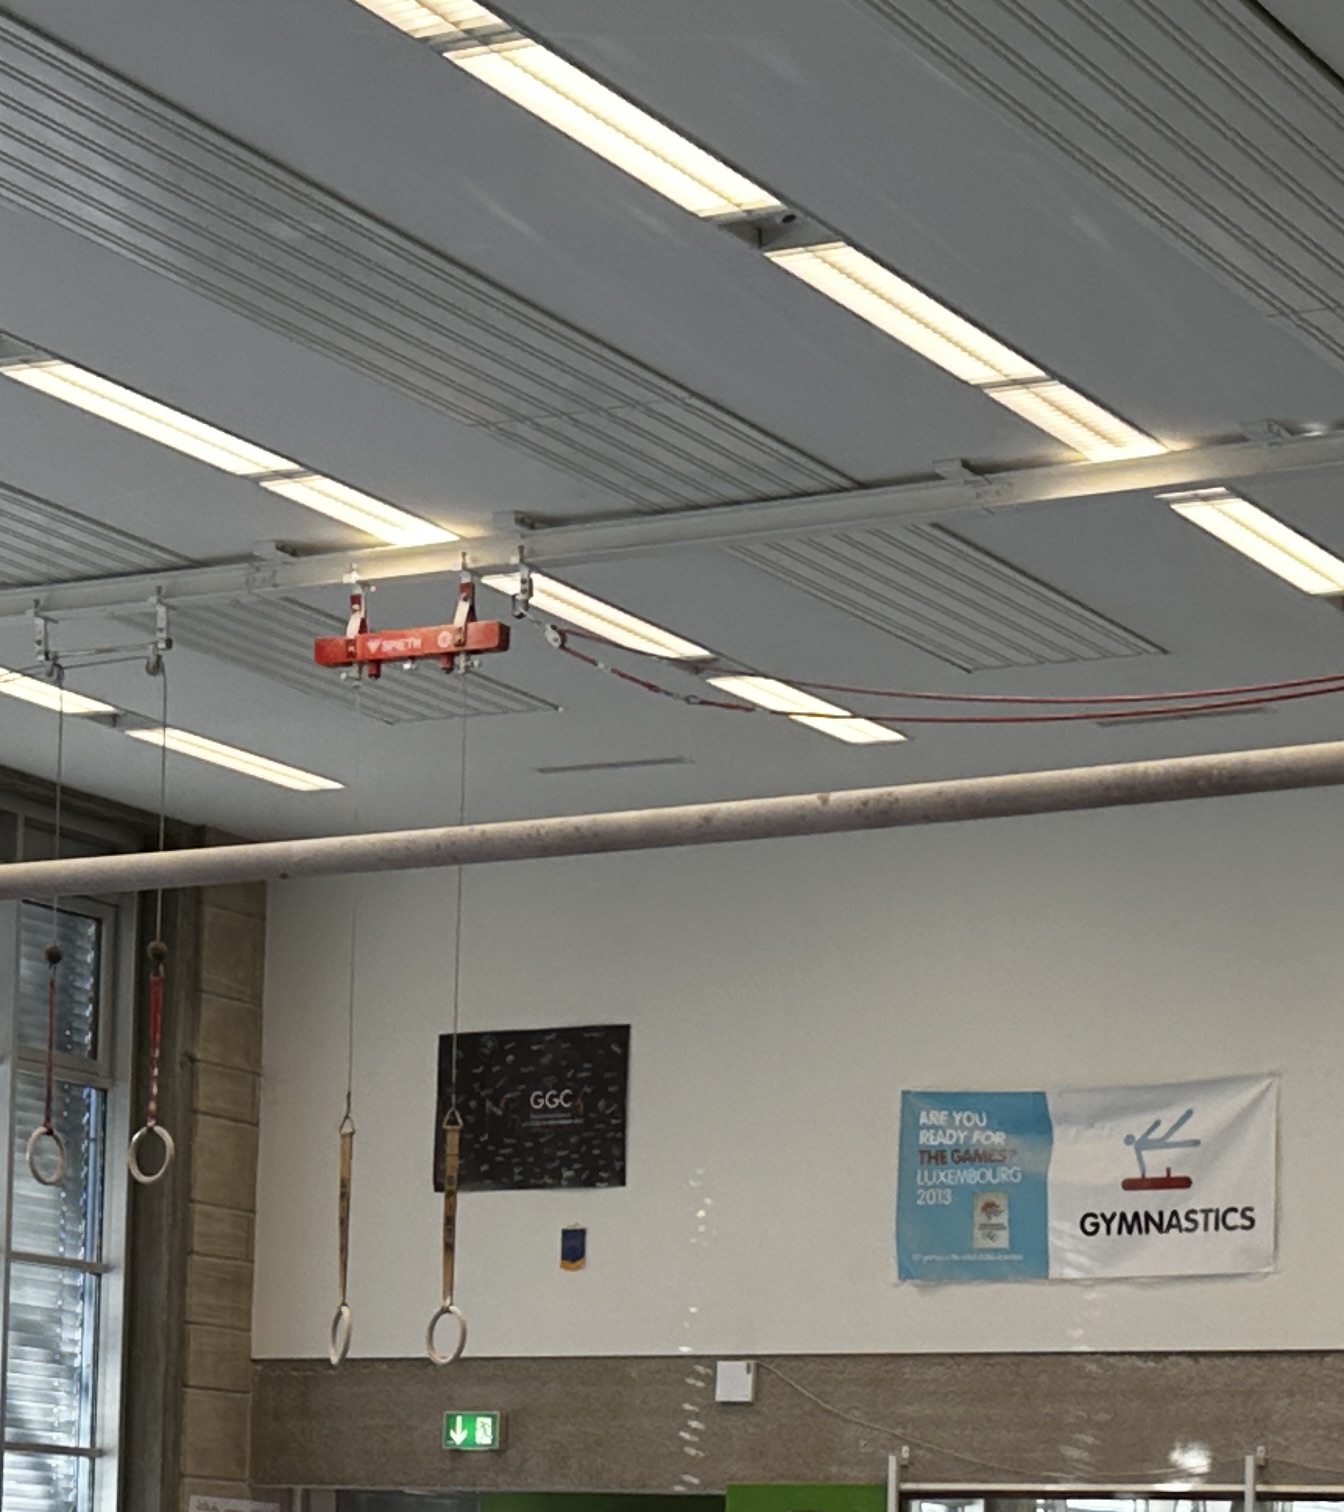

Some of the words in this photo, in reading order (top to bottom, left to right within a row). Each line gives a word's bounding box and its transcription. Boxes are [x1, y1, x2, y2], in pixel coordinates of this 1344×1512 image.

[529, 1089, 573, 1110] GGC
[919, 1110, 949, 1127] ARE
[952, 1110, 987, 1127] YOU
[919, 1129, 968, 1146] READY
[971, 1130, 1006, 1145] FOR
[918, 1149, 948, 1165] THE
[916, 1166, 1022, 1186] LUXEMBOURG
[916, 1188, 953, 1206] 2013
[1079, 1206, 1256, 1237] GYMNASTICS
